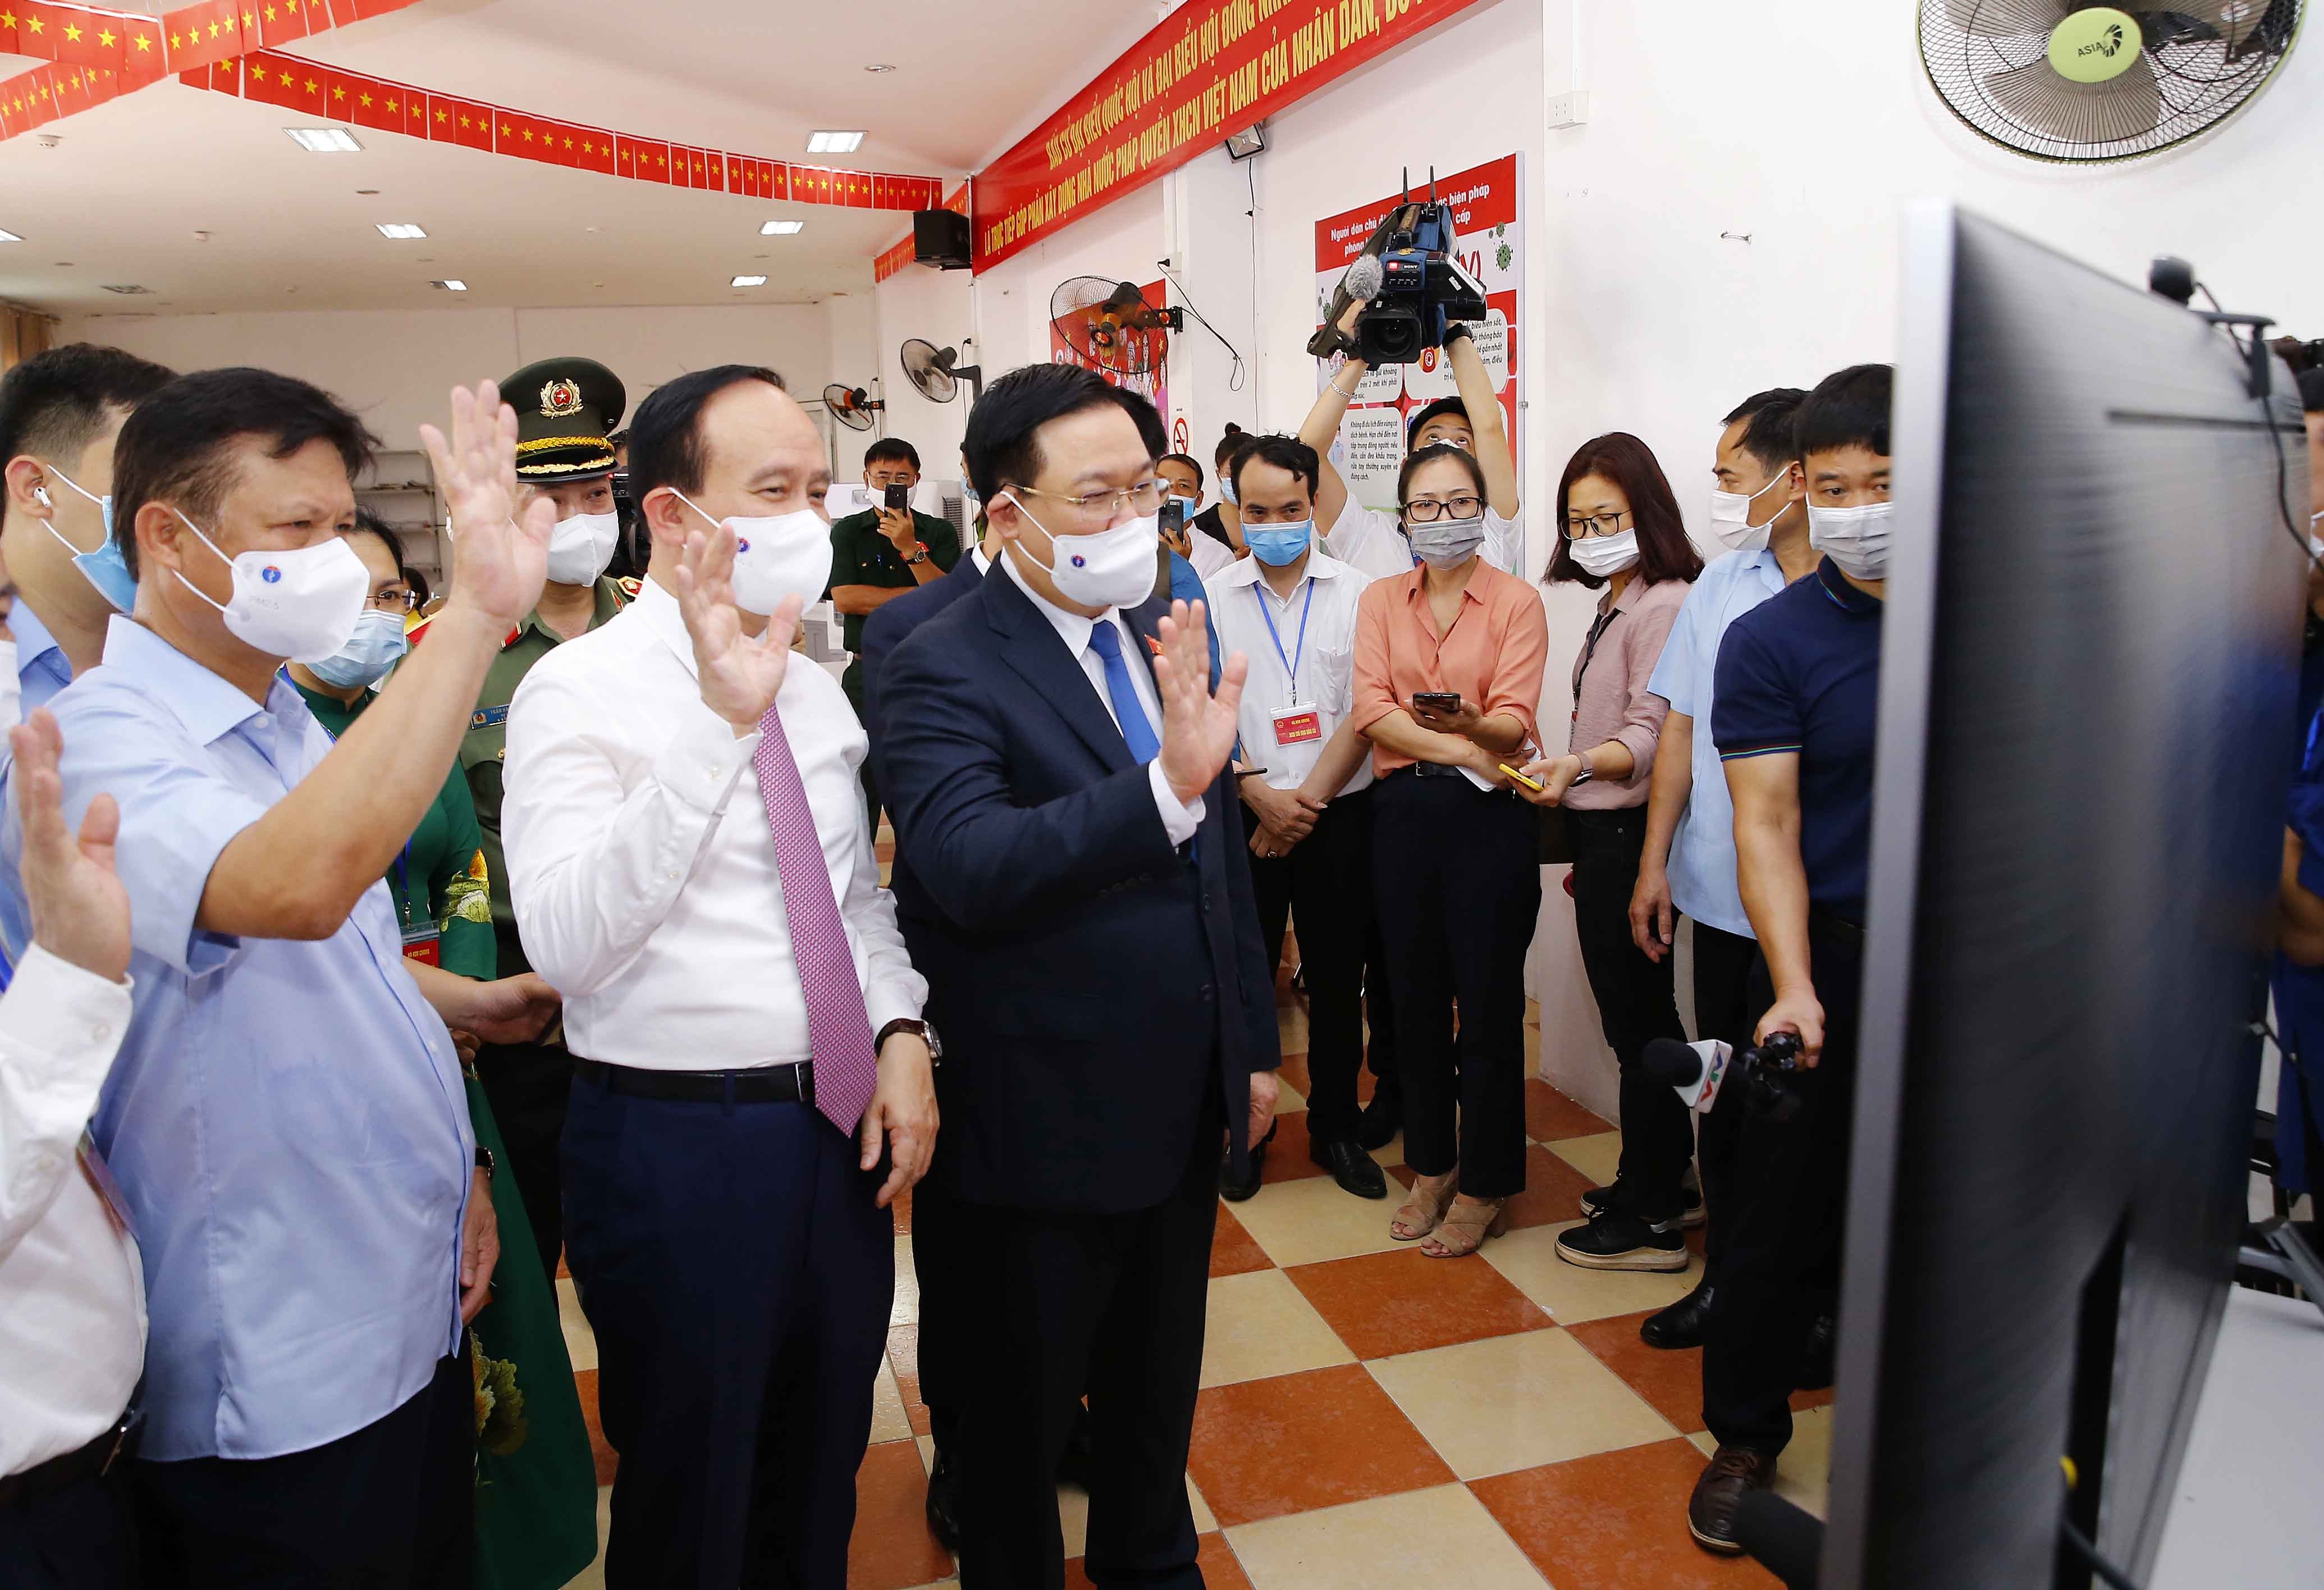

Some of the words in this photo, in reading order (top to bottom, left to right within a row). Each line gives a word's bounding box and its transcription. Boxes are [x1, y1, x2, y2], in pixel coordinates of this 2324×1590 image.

[2078, 42, 2102, 57] ASIA
[1102, 77, 1124, 135] QUỐC
[1125, 69, 1141, 120] HỘI
[1142, 56, 1155, 104] VÀ
[1156, 49, 1173, 98] ĐẠI
[1174, 17, 1198, 82] BIỂU
[1200, 8, 1219, 66] HỘI
[1045, 184, 1056, 222] XÂY
[1077, 159, 1092, 203] NHÀ
[1094, 145, 1114, 195] NƯỚC
[1116, 132, 1138, 182] PHÁP
[1140, 106, 1170, 171] QUYỀN
[1173, 95, 1200, 149] XHCN
[1202, 75, 1227, 134] VIỆT
[1229, 58, 1258, 115] NAM
[1262, 25, 1289, 95] CỦA
[1292, 6, 1335, 78] NHÂN
[1331, 226, 1349, 242] Người
[1351, 223, 1363, 235] dân
[1365, 217, 1377, 231] chủ
[1449, 191, 1466, 206] biện
[1468, 182, 1490, 203] pháp
[1456, 208, 1471, 225] cấp
[1479, 332, 1493, 341] thông
[1493, 330, 1502, 339] báo
